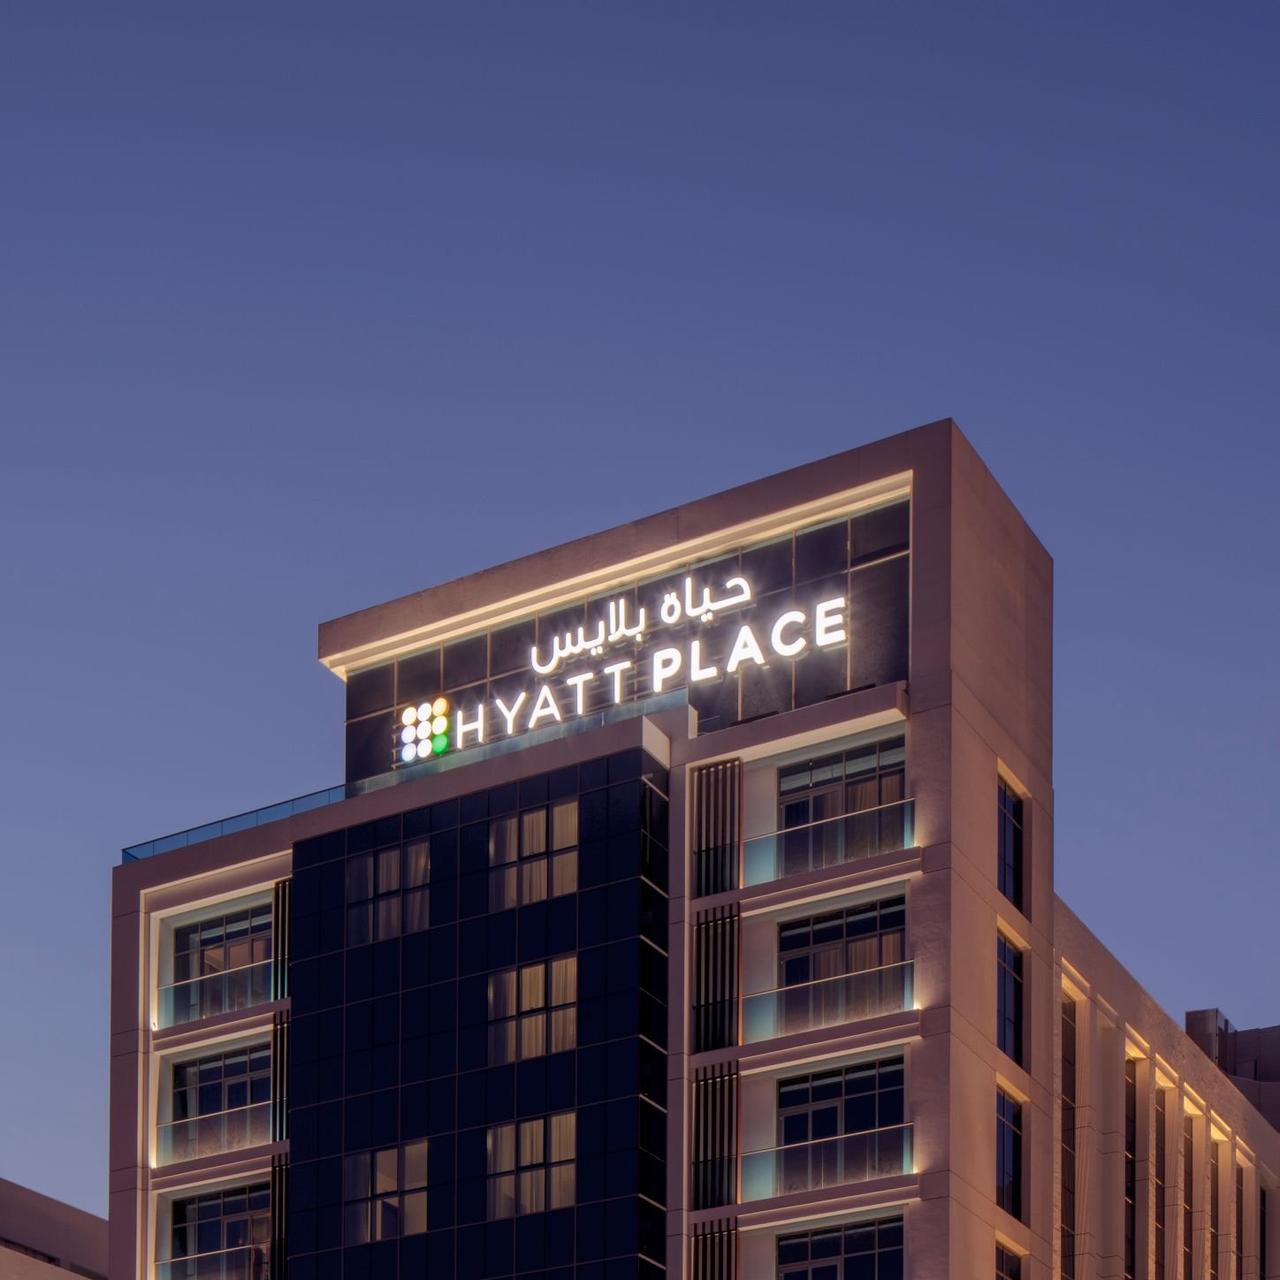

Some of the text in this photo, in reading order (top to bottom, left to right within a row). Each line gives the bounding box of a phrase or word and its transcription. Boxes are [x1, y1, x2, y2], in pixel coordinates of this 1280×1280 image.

[456, 597, 847, 749] HYATT PLACE
[530, 576, 752, 675] حياة بلايس
